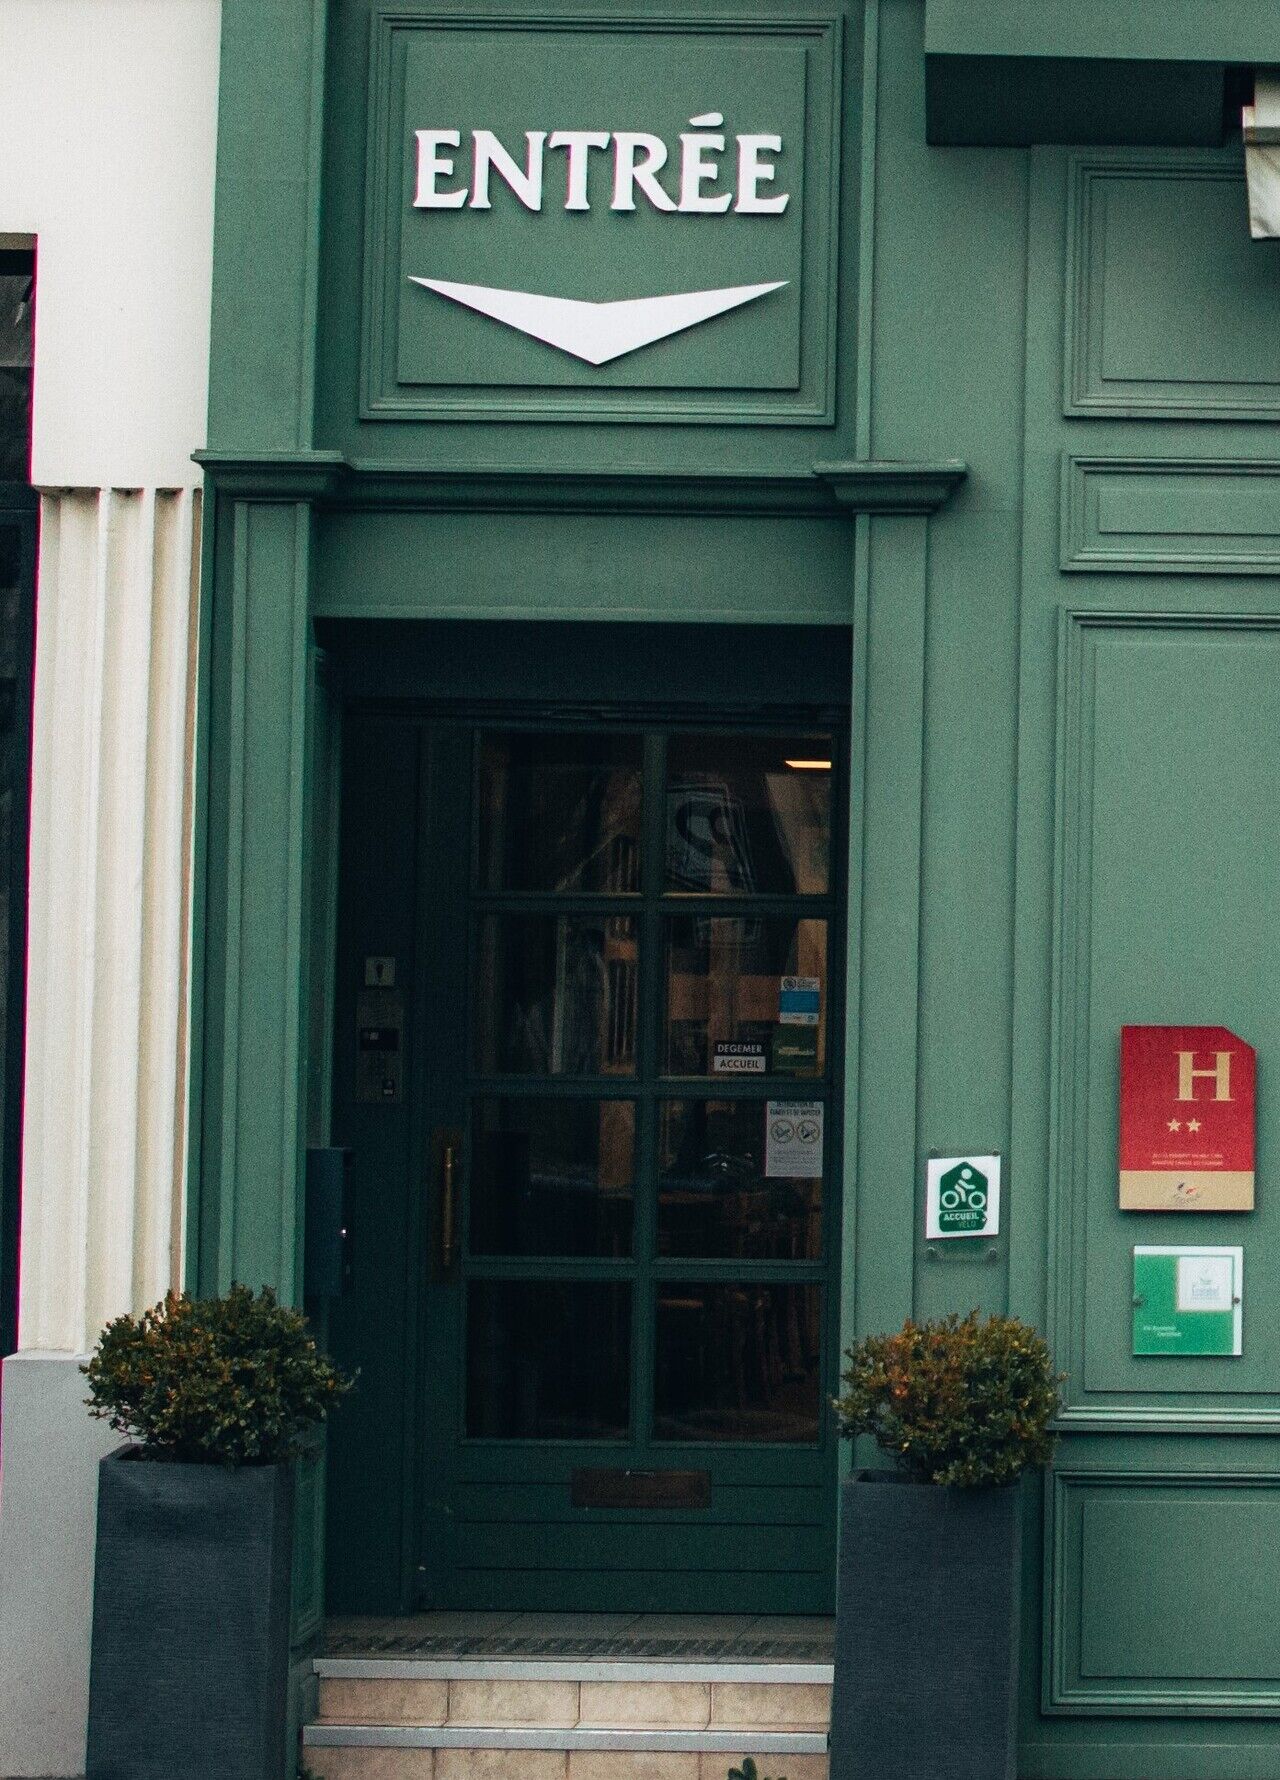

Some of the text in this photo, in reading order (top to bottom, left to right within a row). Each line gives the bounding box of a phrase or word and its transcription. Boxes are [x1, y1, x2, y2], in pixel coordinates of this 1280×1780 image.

[413, 112, 789, 213] ENTRÉE
[717, 1044, 763, 1053] DEGEMER
[719, 1059, 760, 1069] ACCUEIL
[1174, 1050, 1236, 1102] H
[943, 1211, 980, 1221] ACCUEIL
